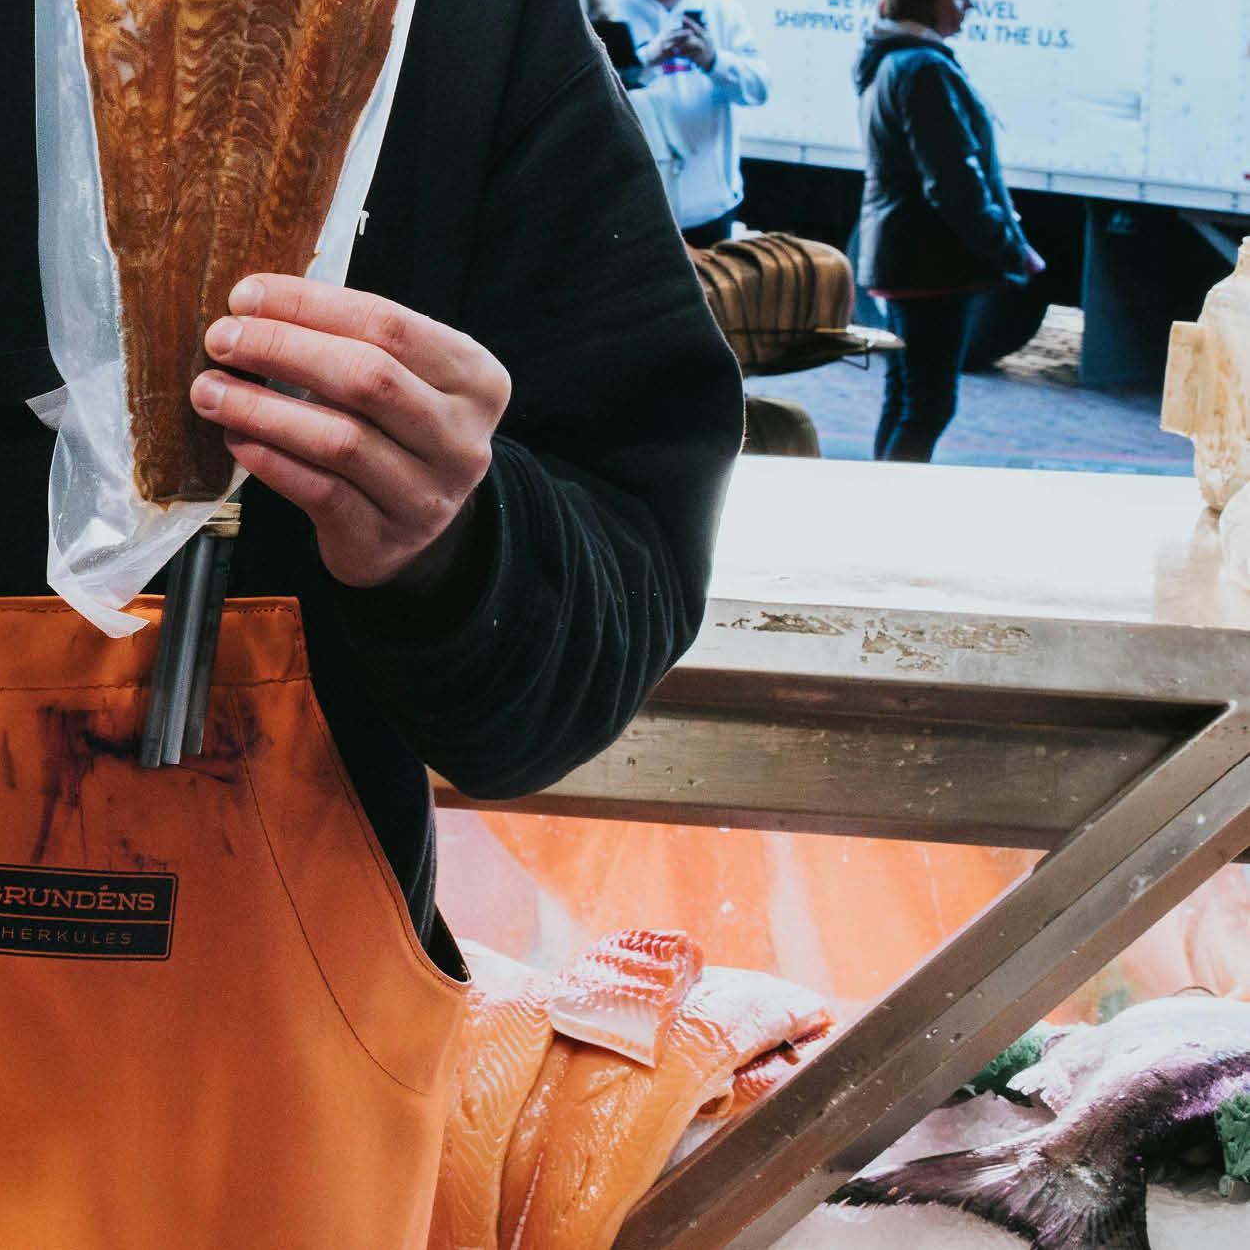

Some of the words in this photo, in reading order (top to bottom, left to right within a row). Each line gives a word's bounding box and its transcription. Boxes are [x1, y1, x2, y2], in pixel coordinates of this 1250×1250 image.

[774, 8, 855, 31] SHIPPING
[968, 24, 987, 42] IN
[996, 25, 1031, 46] THE
[1, 925, 133, 945] HERKULES
